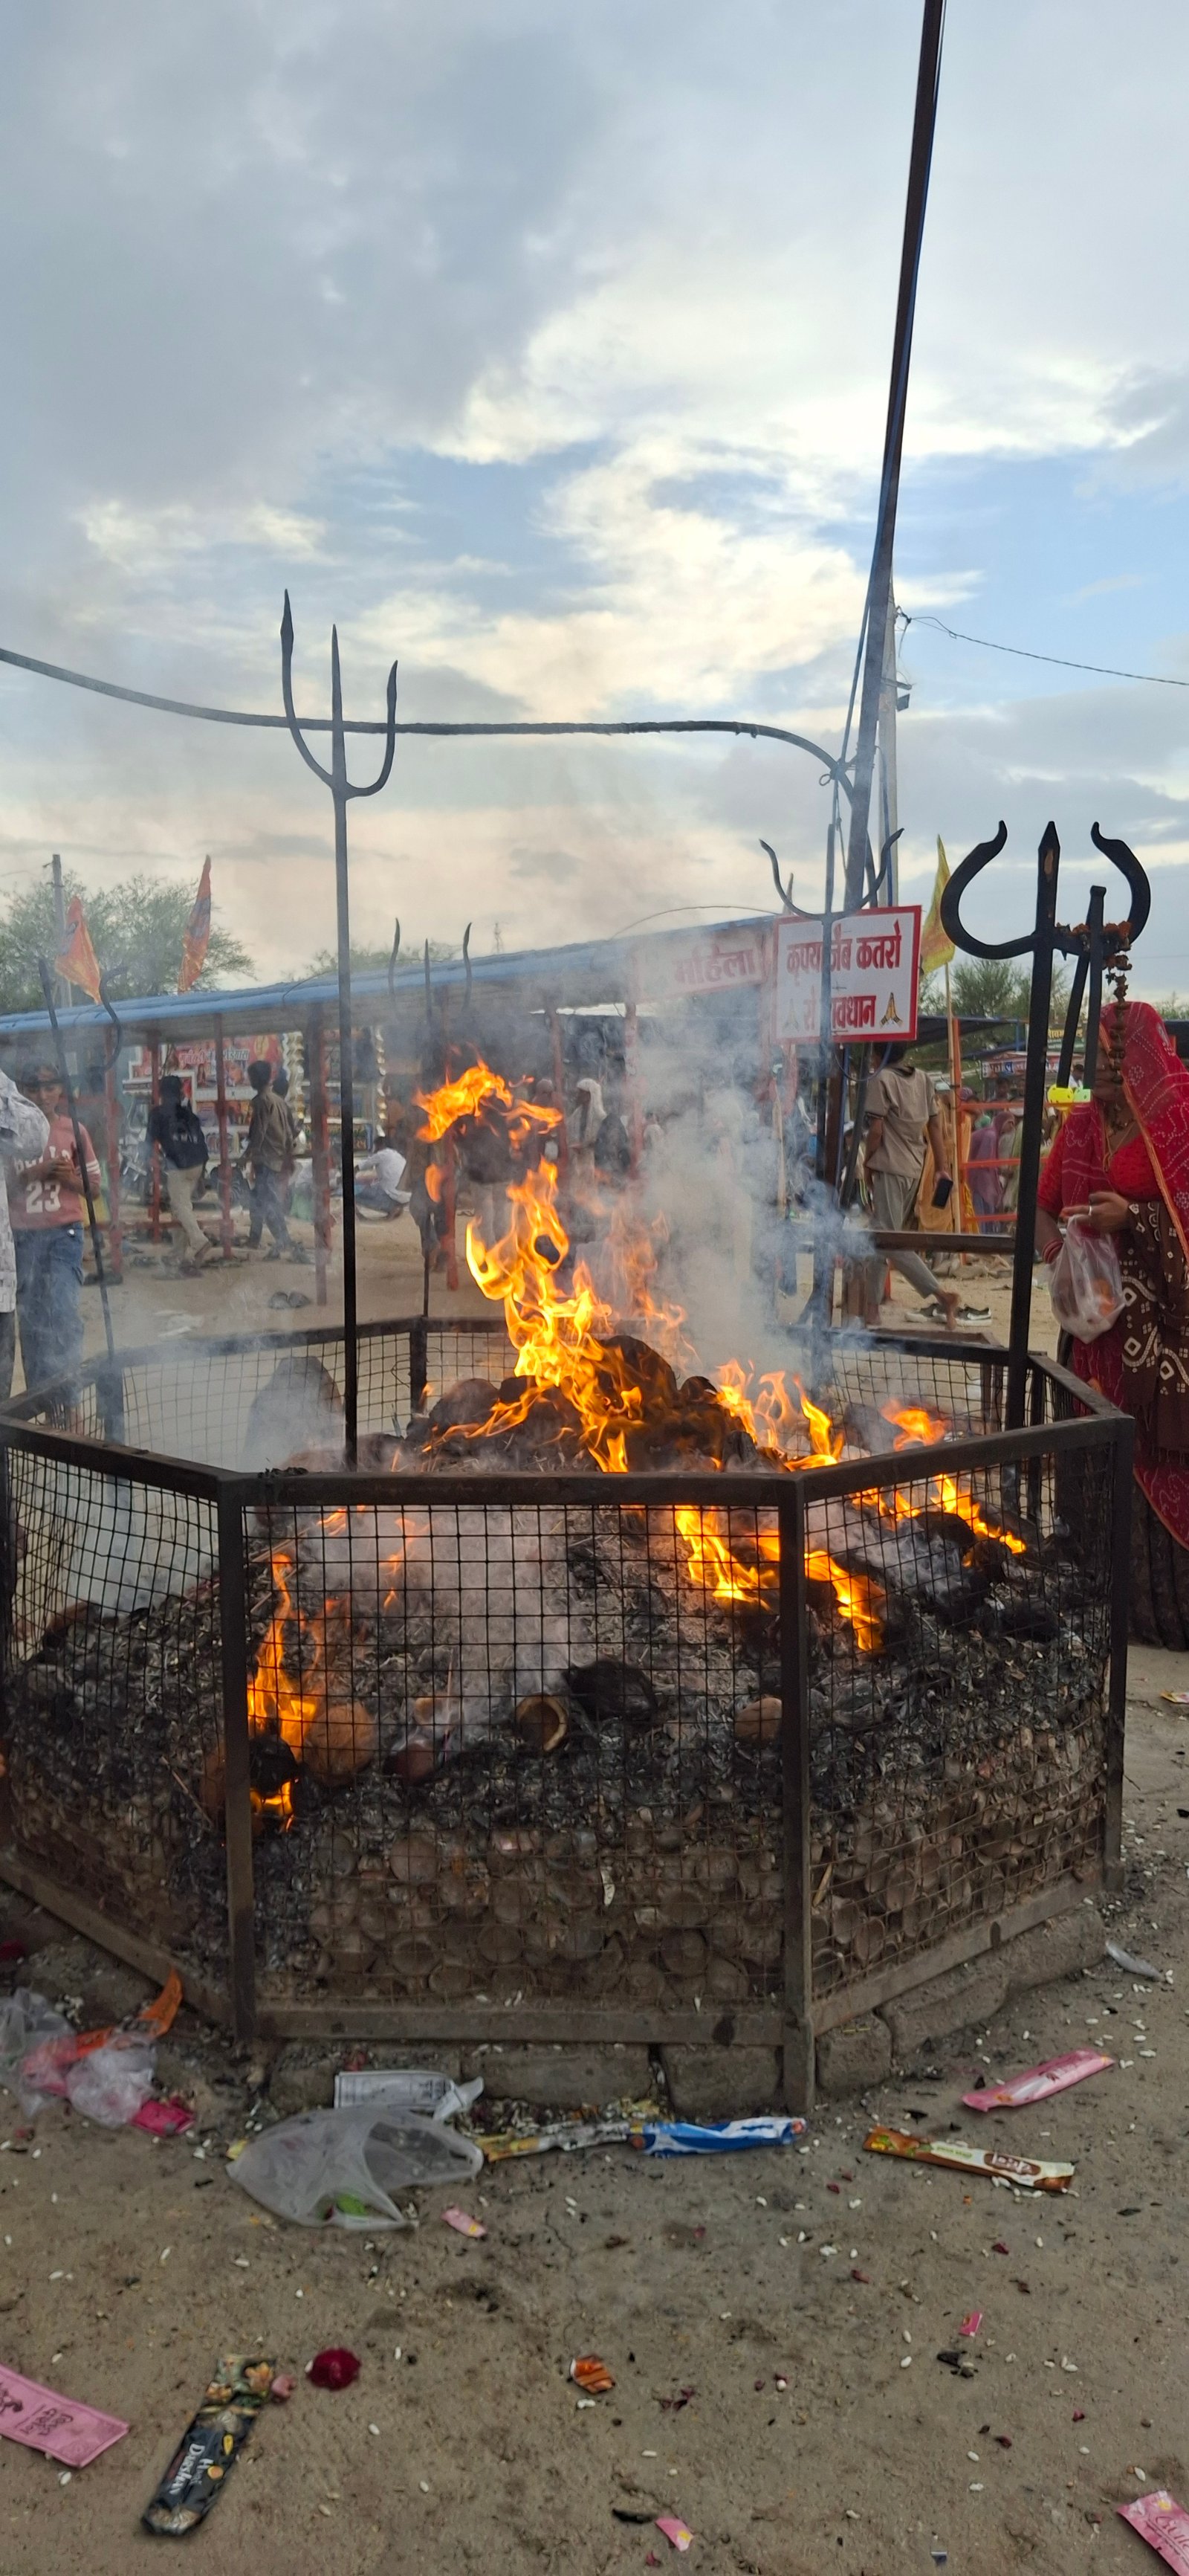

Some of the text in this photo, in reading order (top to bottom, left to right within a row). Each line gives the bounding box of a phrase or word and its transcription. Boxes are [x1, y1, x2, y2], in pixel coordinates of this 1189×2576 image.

[856, 919, 901, 970] कतरो
[831, 995, 876, 1029] ावधान
[26, 1180, 61, 1213] 23
